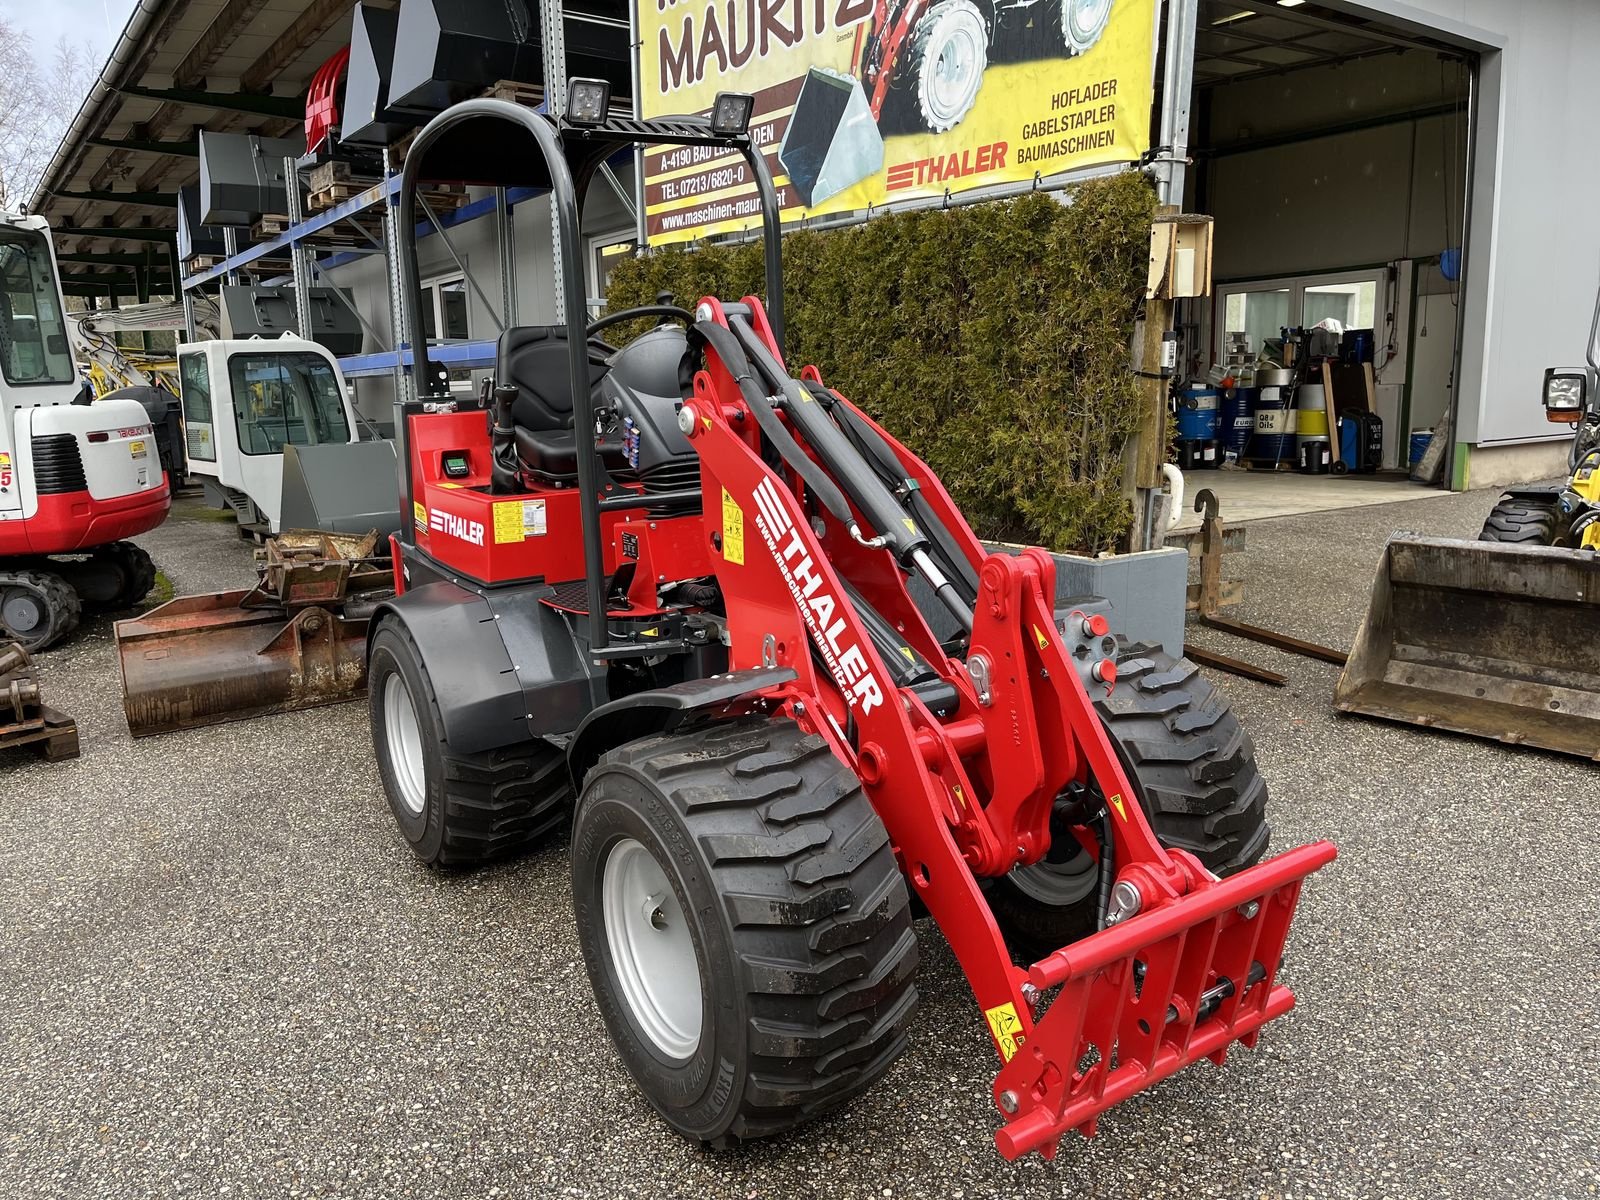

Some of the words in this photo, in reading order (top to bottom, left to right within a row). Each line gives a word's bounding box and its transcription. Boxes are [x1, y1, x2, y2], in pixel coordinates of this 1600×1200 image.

[1051, 79, 1117, 110] HOFLADER
[1022, 104, 1116, 140] GABELSTAPLER
[660, 148, 691, 172] A-4190
[693, 145, 712, 162] BAD
[914, 141, 1008, 186] THALER
[1017, 129, 1116, 164] BAUMASCHINEN
[661, 182, 679, 200] TEL:
[680, 165, 744, 196] 07213/6820-0
[442, 513, 485, 547] THALER
[755, 513, 859, 708] www.maschinen-mauritz.at
[783, 526, 884, 717] THALER
